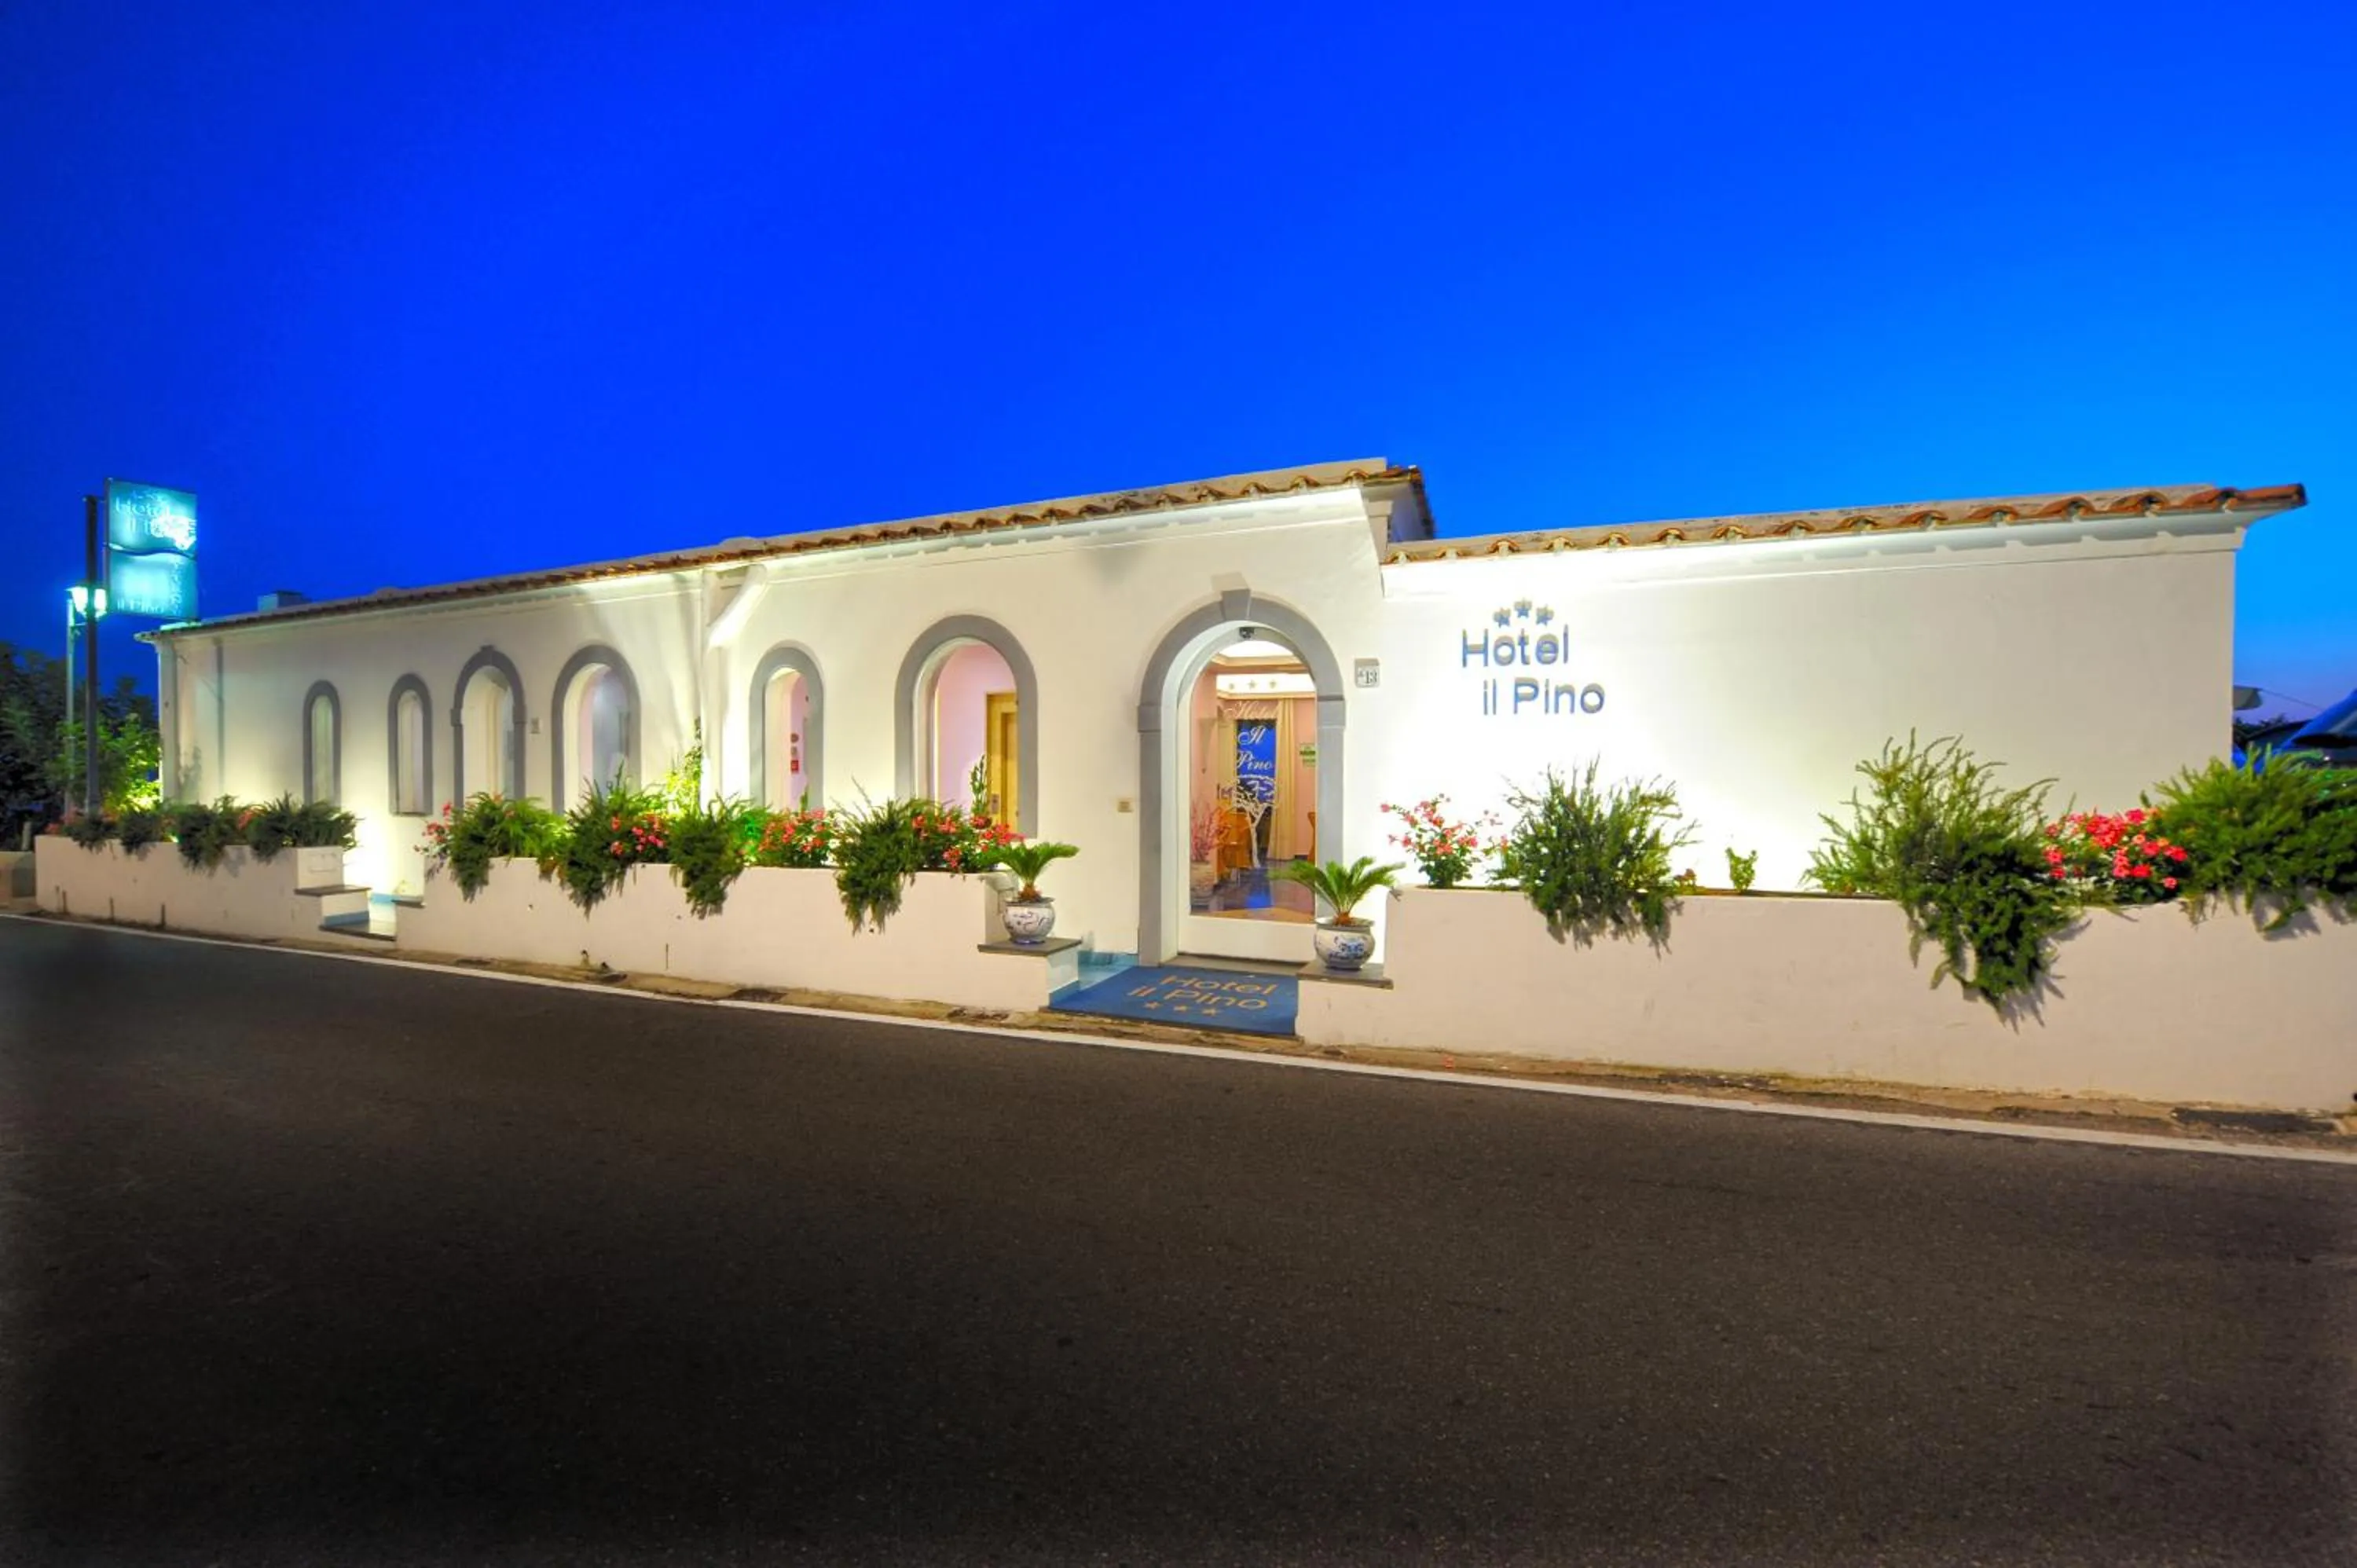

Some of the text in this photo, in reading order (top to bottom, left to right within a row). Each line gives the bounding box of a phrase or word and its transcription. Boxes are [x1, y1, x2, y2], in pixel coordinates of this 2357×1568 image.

[1462, 624, 1569, 668] Hotel
[1513, 676, 1605, 715] Pino
[1236, 750, 1273, 771] Pino
[1160, 975, 1279, 995] Hotel
[1163, 988, 1268, 1009] Pino
